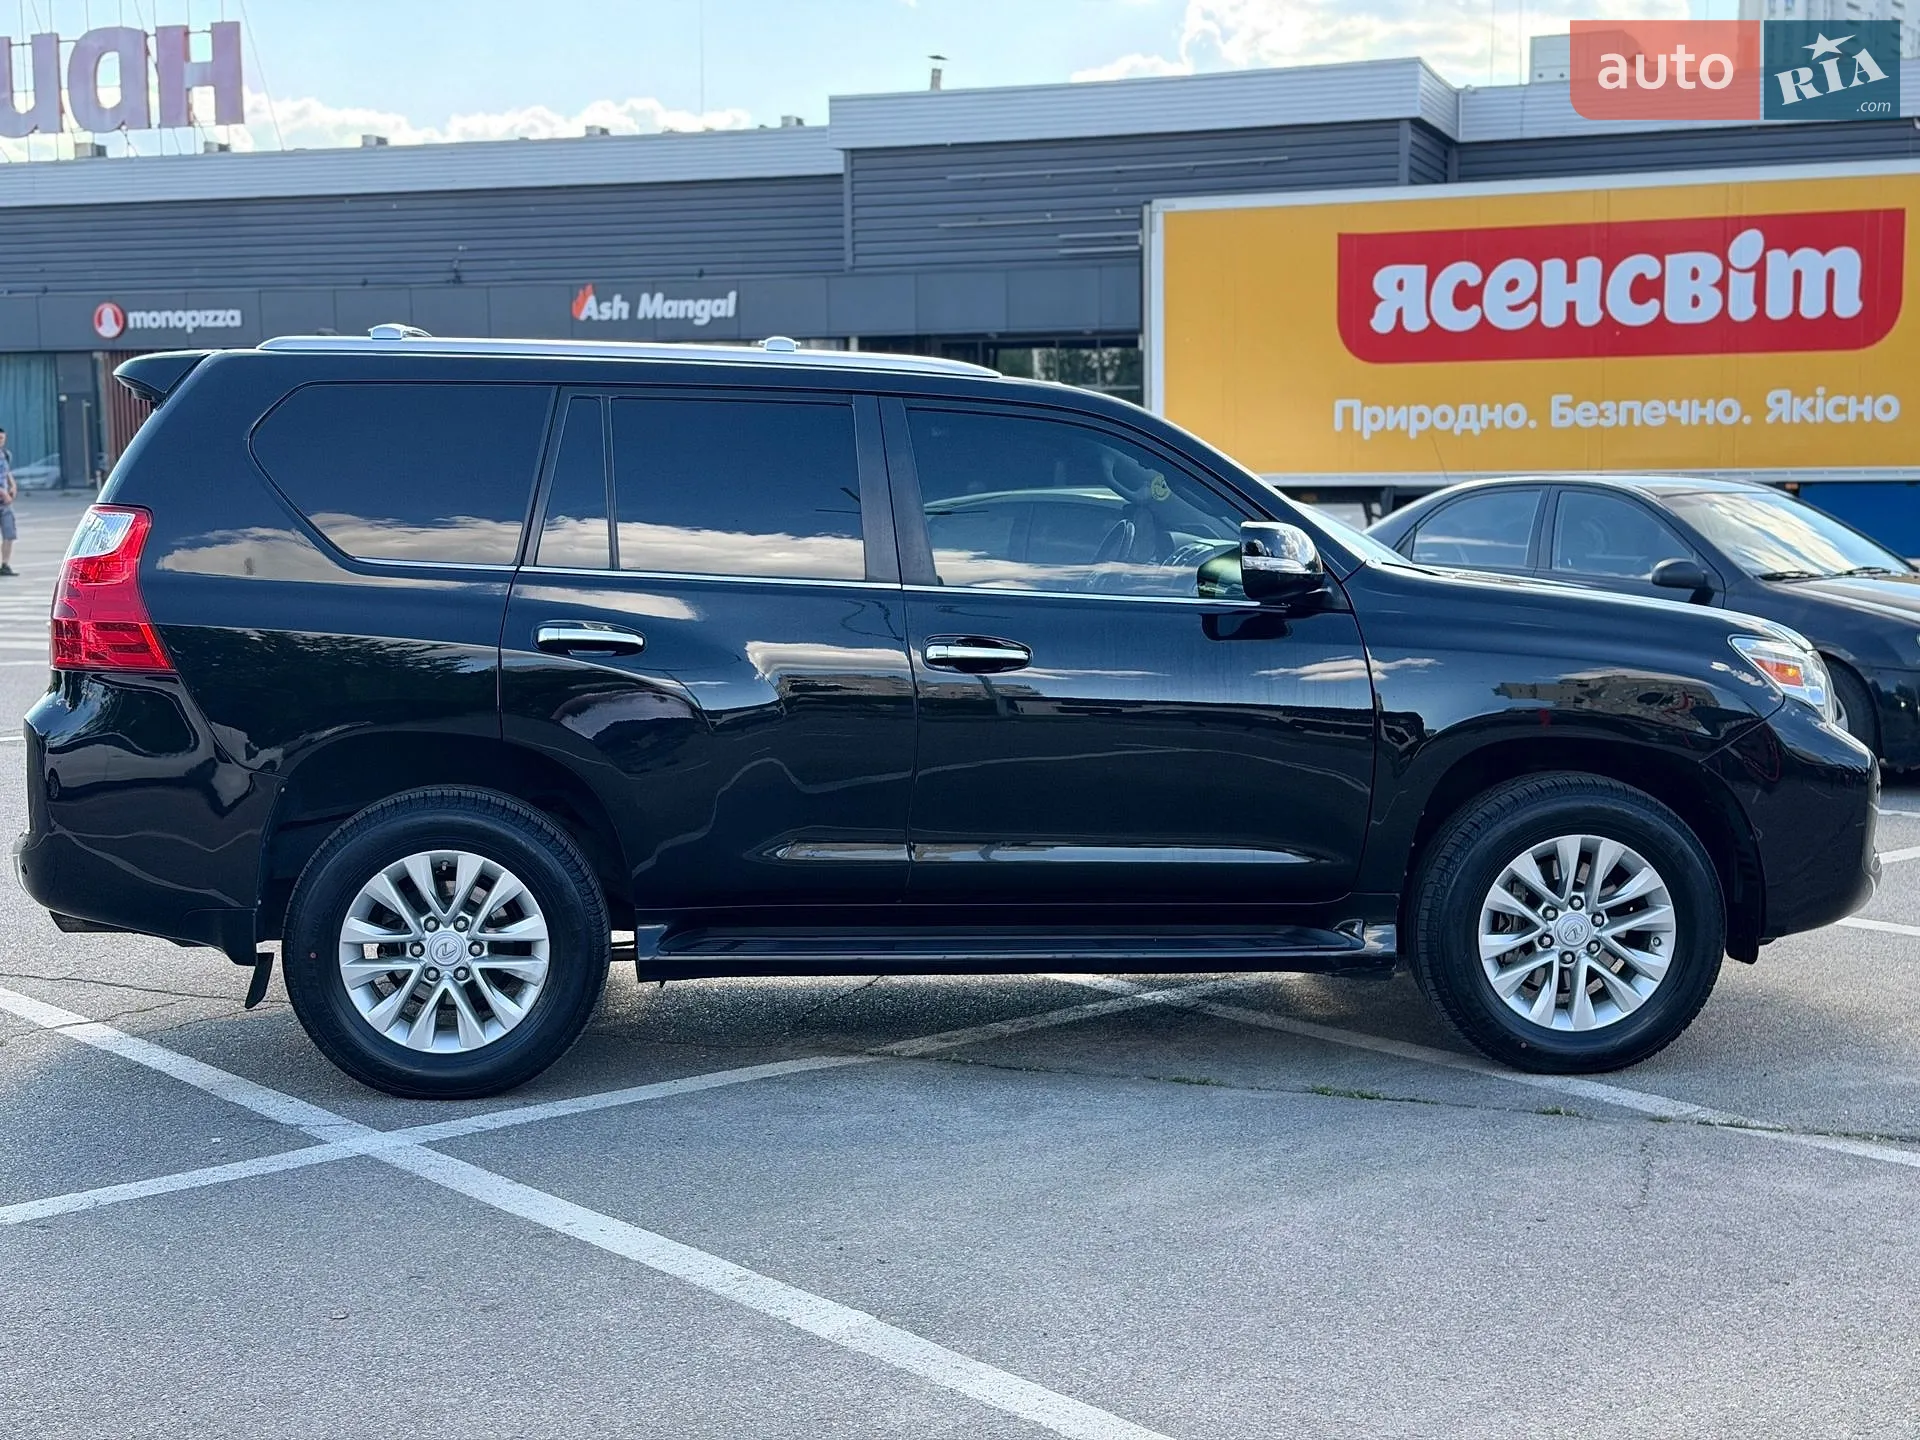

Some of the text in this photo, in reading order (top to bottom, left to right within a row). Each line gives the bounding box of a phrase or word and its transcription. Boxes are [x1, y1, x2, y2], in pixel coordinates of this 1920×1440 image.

[127, 309, 242, 334] monopizza
[579, 290, 738, 327] Ash Mangal
[1333, 386, 1902, 441] Природно. Безпечно. Якісно
